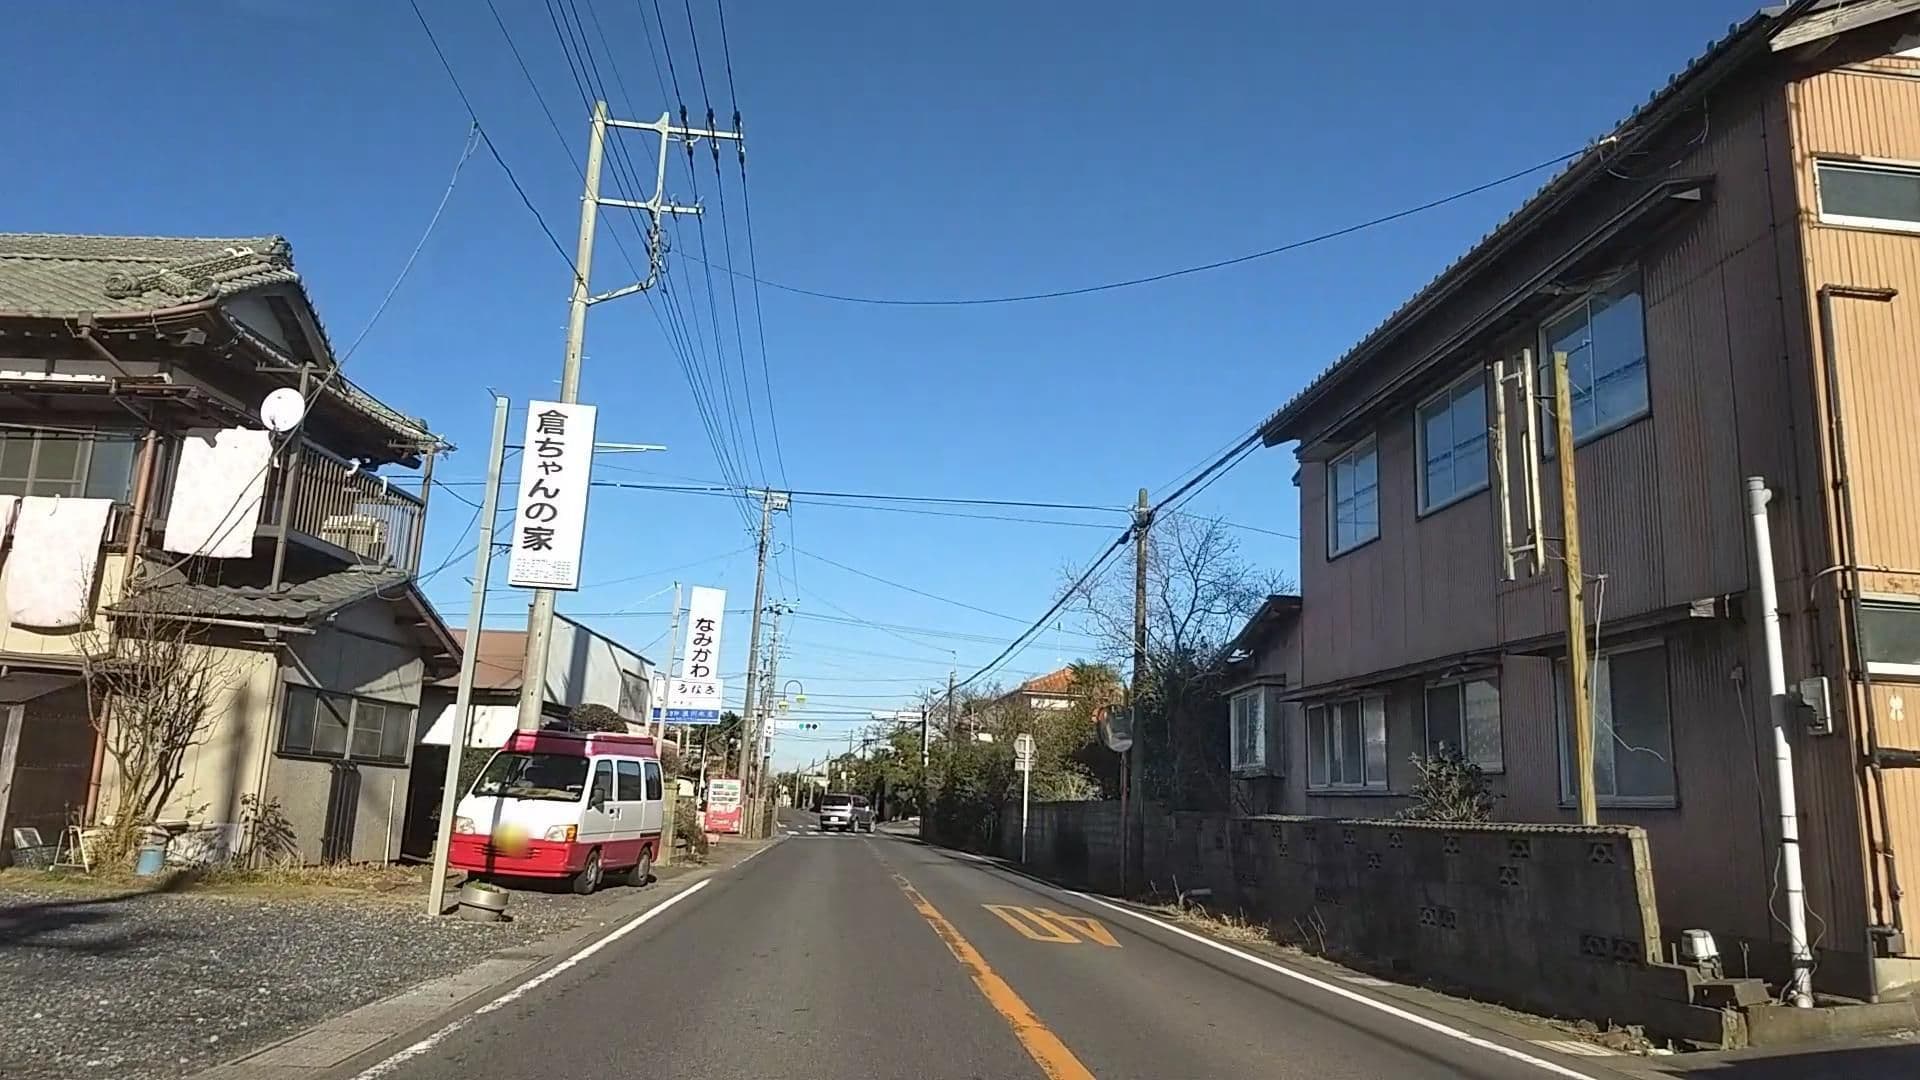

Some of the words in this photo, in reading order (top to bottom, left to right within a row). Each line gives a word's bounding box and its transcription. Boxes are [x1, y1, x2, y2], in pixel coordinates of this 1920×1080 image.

[521, 409, 569, 552] 倉ちゃんの家
[689, 617, 716, 678] なみかわ
